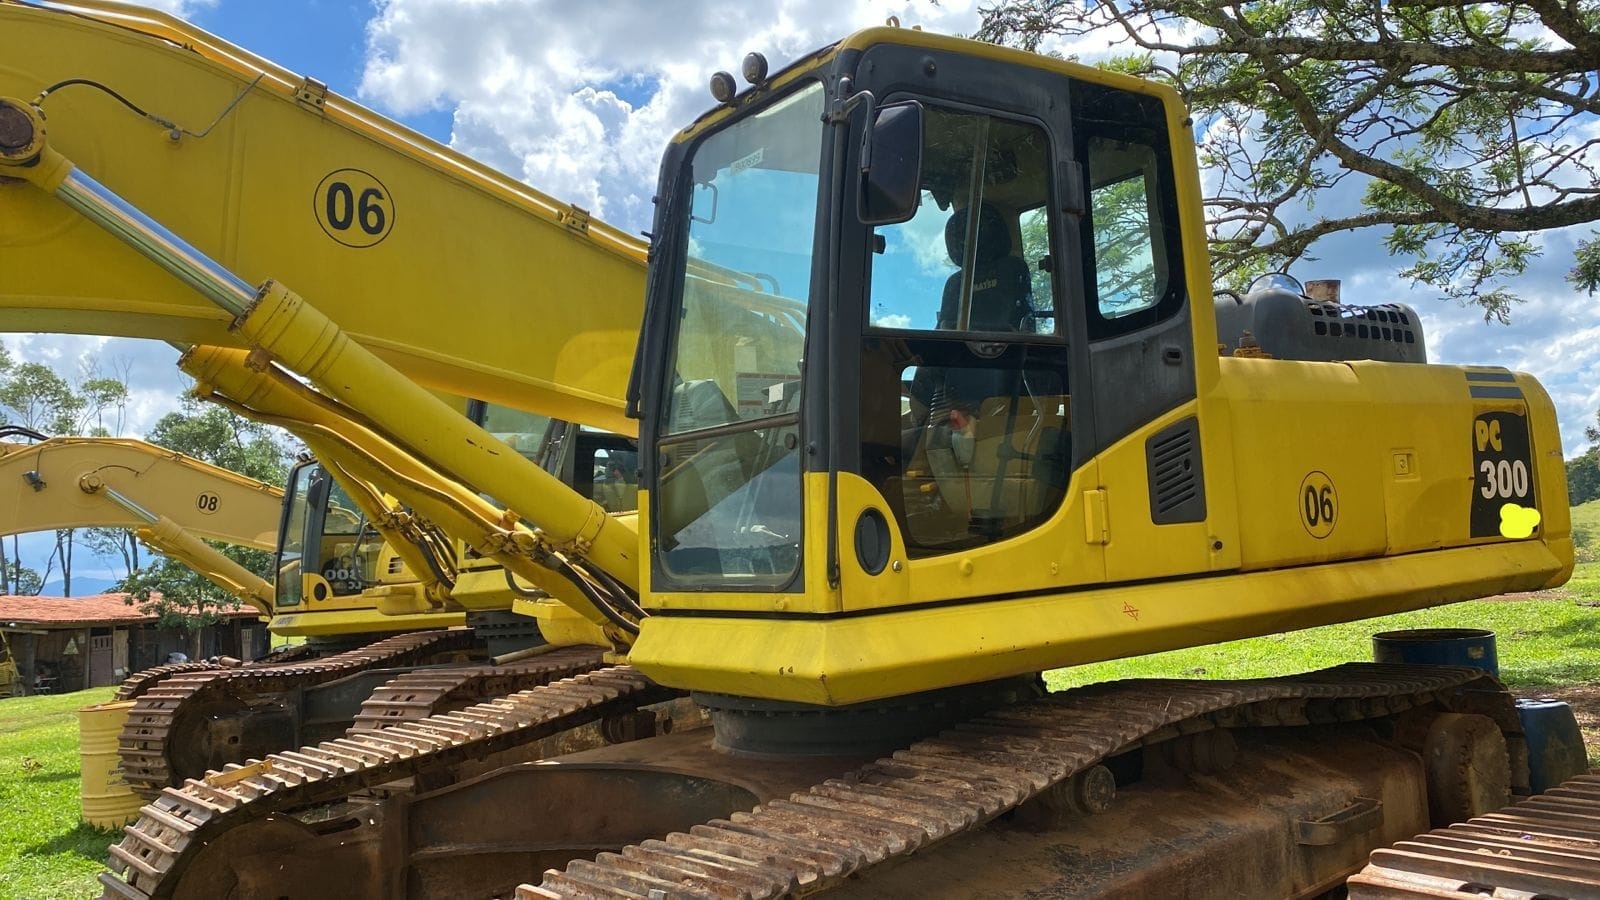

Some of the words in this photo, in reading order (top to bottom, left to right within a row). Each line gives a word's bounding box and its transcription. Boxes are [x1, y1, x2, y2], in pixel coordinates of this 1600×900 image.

[326, 181, 386, 236] 06
[1475, 419, 1503, 452] PC
[1480, 459, 1529, 499] 300
[198, 494, 218, 512] 08
[1304, 484, 1335, 527] 06
